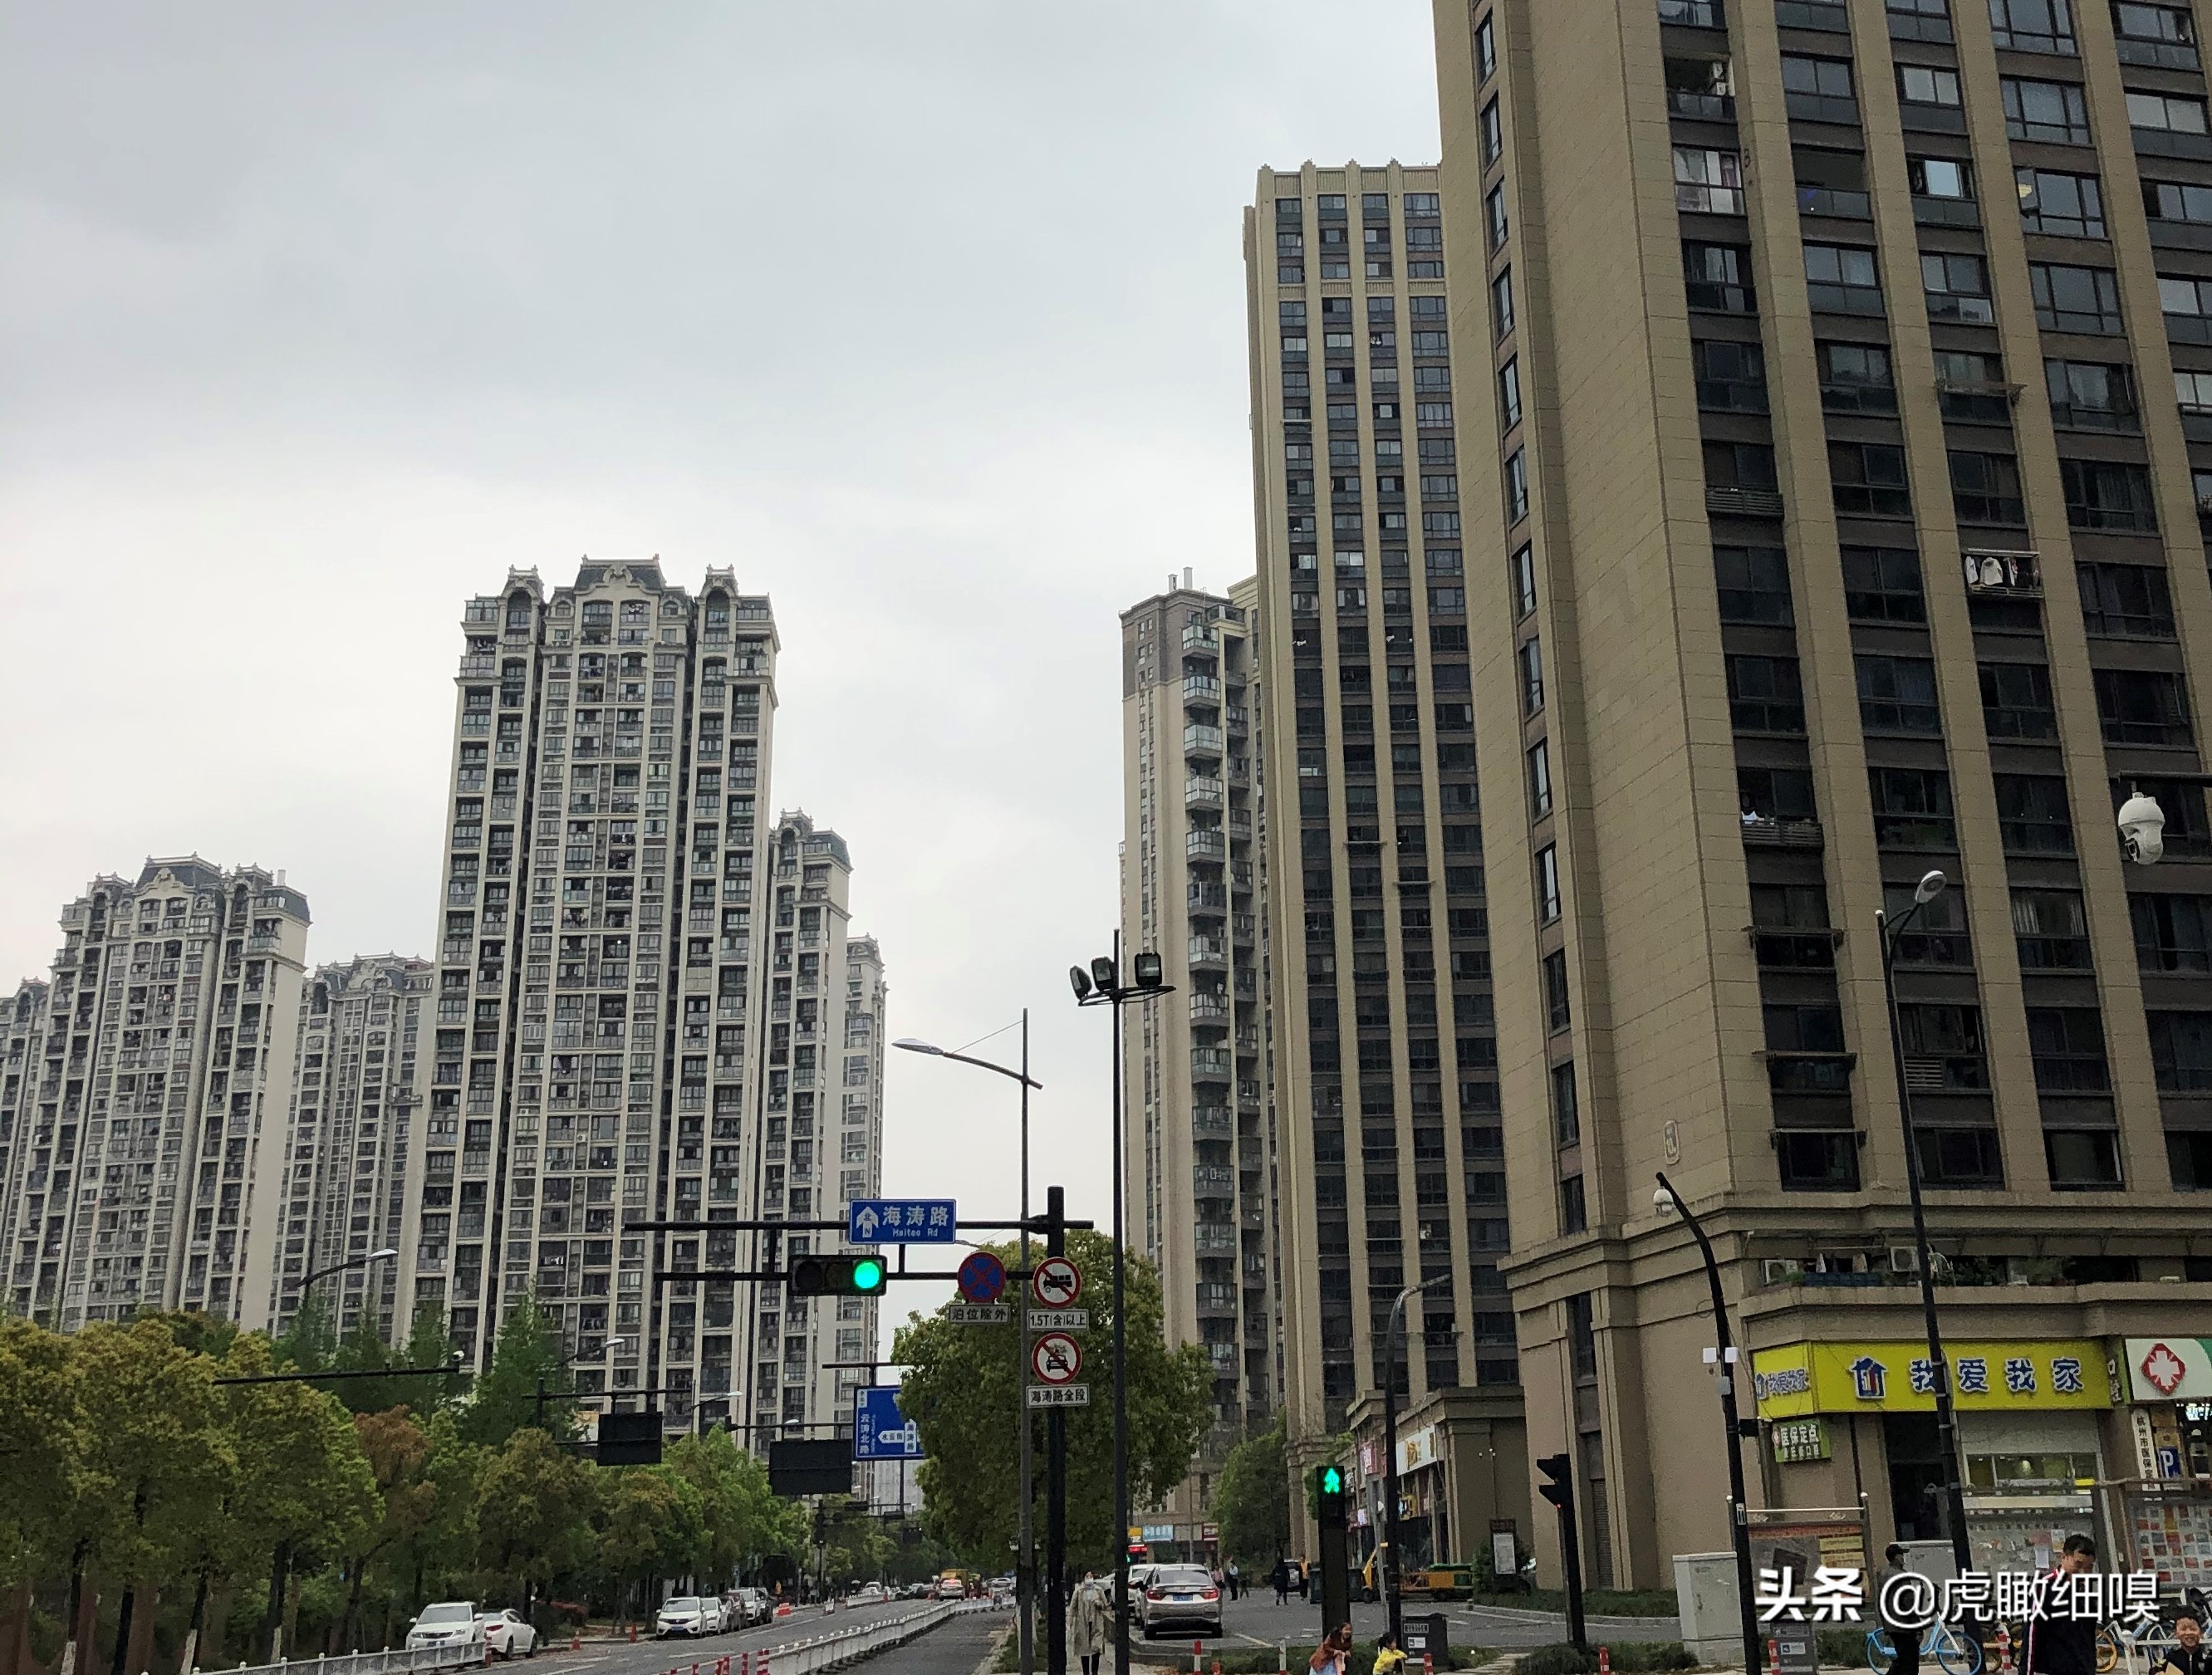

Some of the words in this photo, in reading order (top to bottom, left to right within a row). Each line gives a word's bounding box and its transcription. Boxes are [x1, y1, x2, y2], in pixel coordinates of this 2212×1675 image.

[881, 1206, 949, 1227] 海涛路
[892, 1228, 921, 1237] Haitao
[927, 1228, 938, 1237] Rd
[951, 1308, 1007, 1320] 泊位除外
[1910, 1356, 2084, 1393] 我爱我家
[1031, 1388, 1086, 1403] 海涛路全段
[1780, 1423, 1819, 1446] 医保定点
[2160, 1450, 2174, 1479] P
